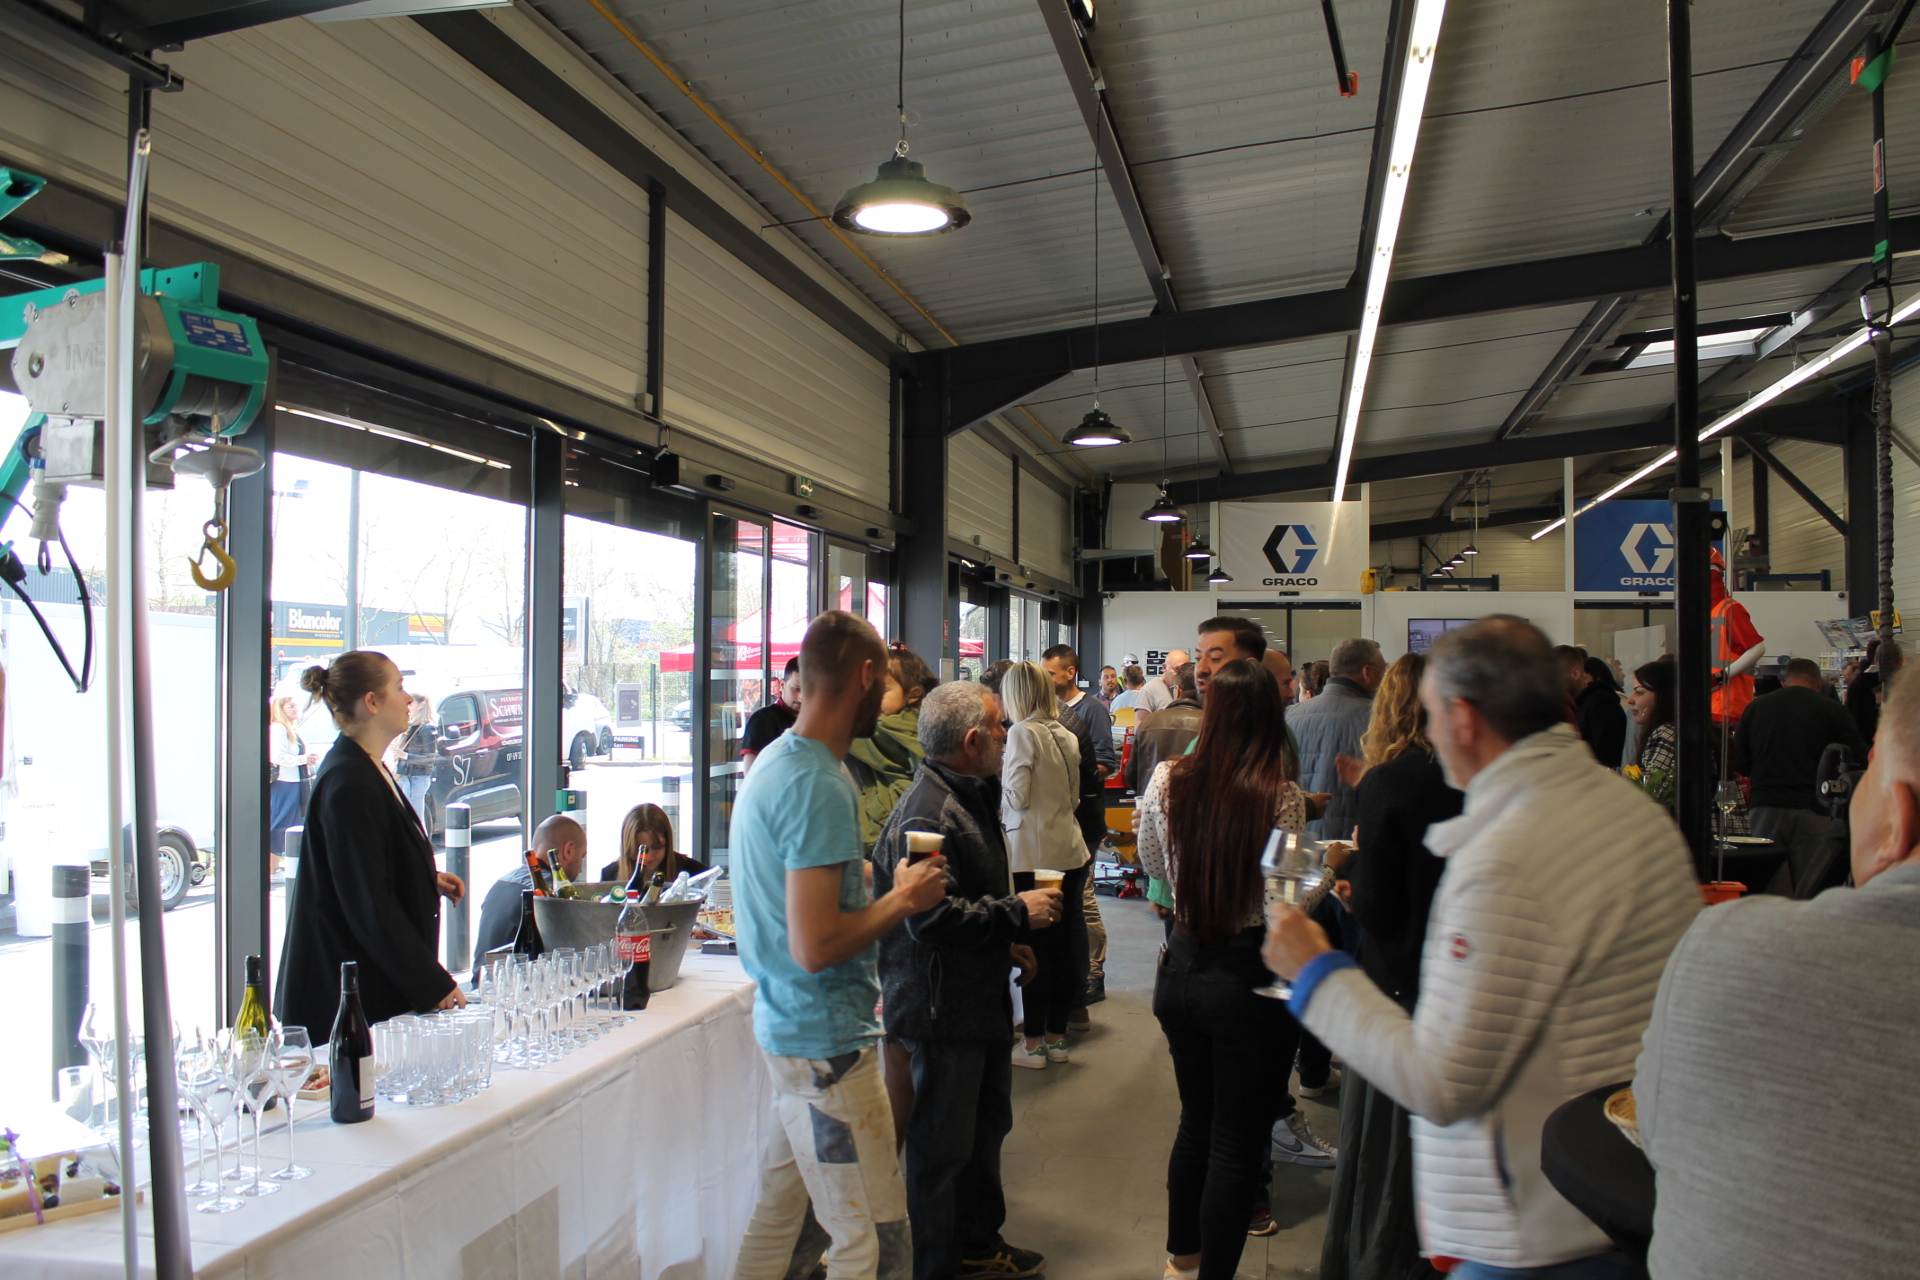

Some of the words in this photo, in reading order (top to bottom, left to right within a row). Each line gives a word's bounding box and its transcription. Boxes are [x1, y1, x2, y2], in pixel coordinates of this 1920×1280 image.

[65, 340, 106, 371] IME
[1262, 578, 1318, 586] GRACO
[288, 608, 342, 631] Blancolor
[490, 698, 523, 718] SCHWA
[452, 754, 474, 787] SZ
